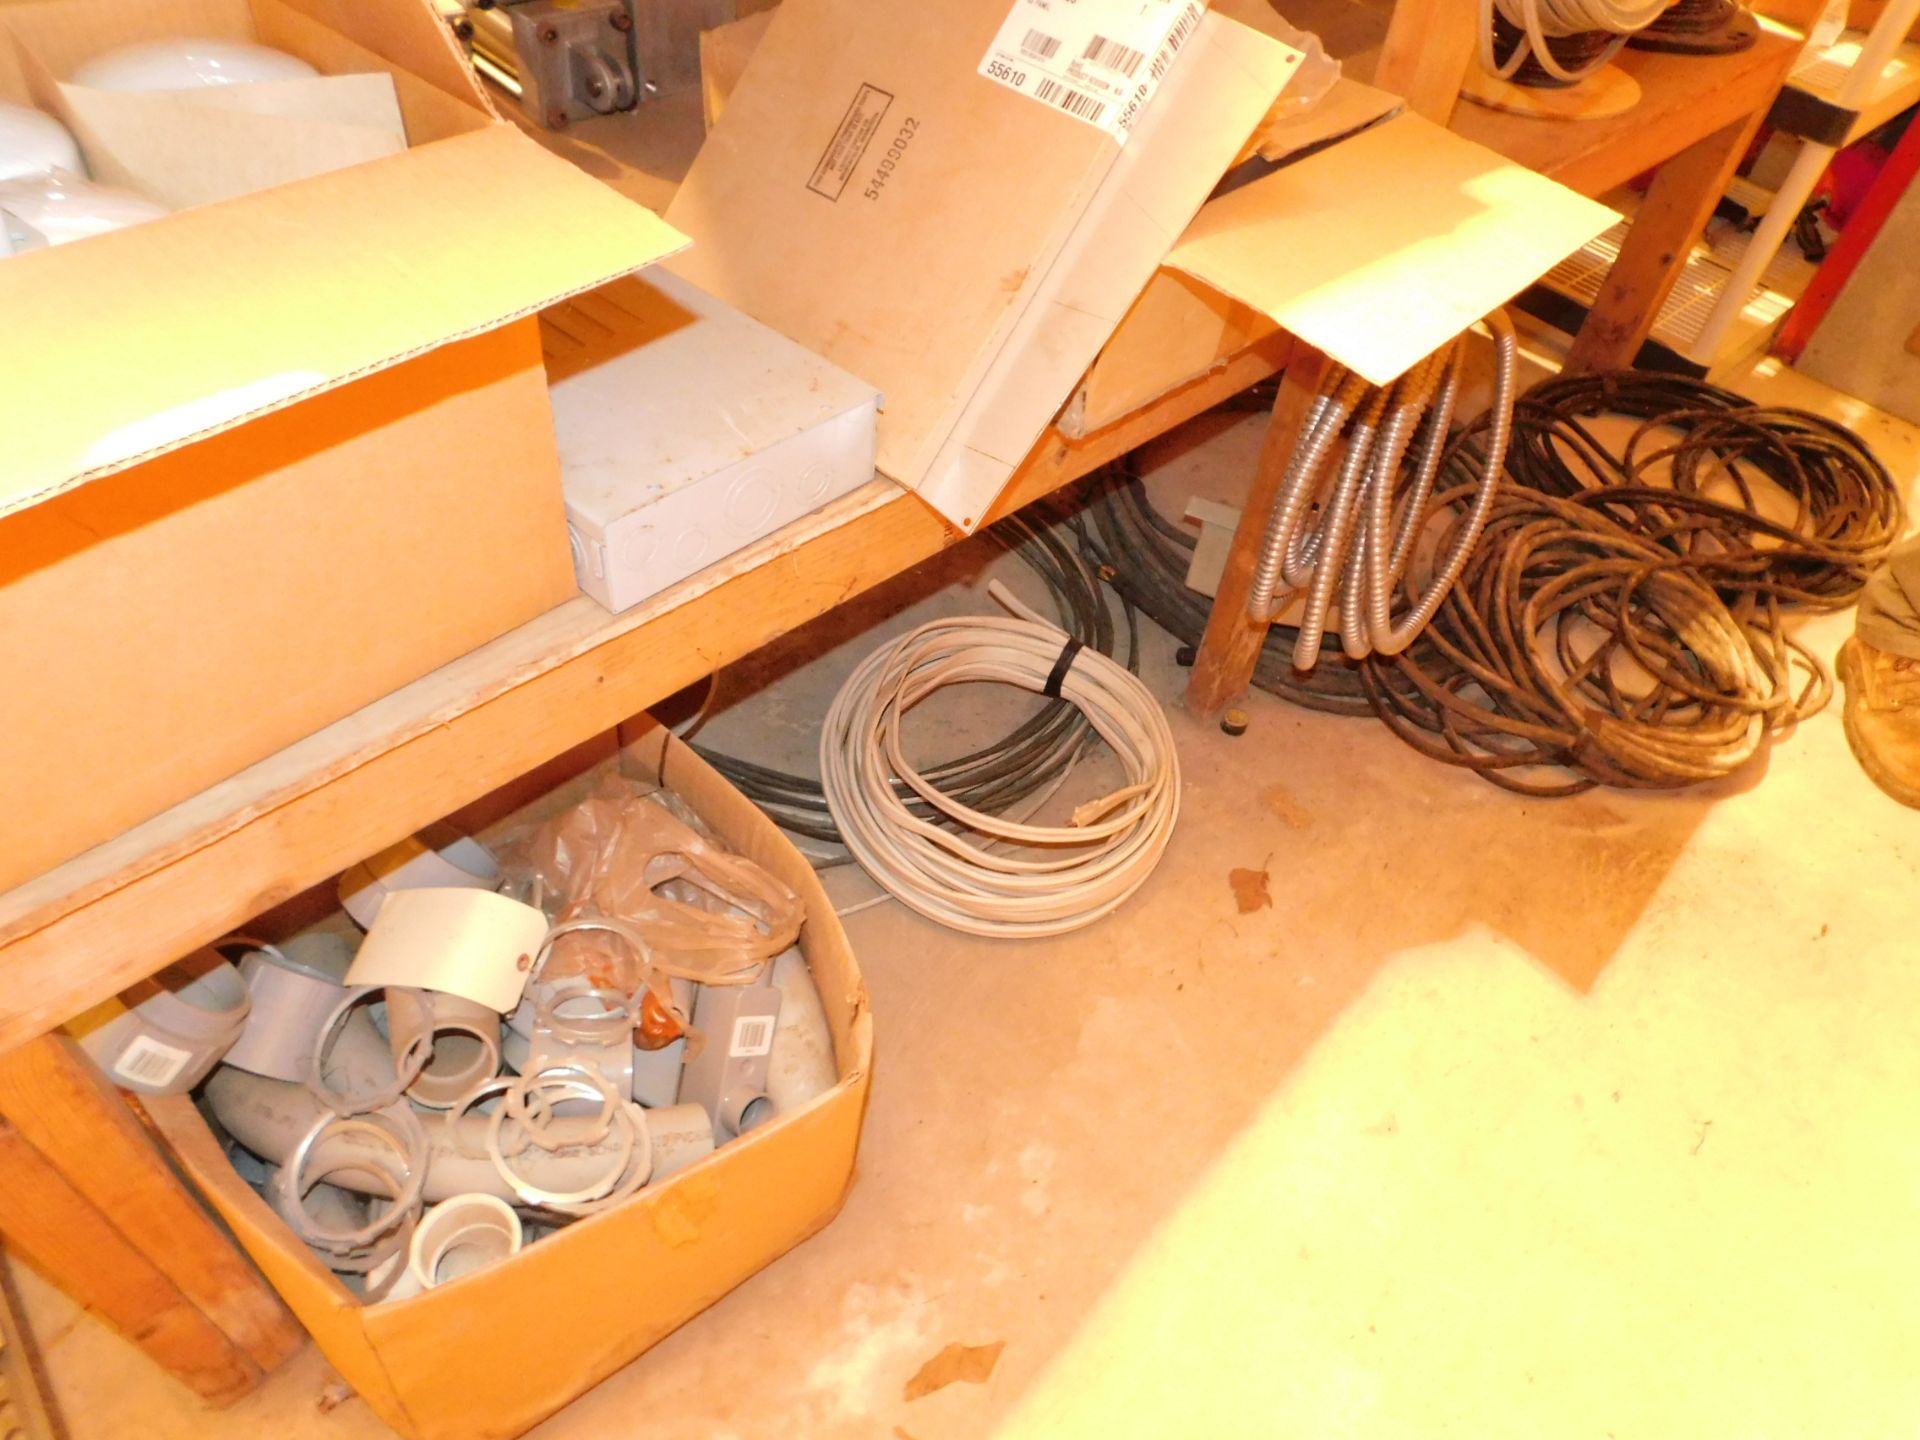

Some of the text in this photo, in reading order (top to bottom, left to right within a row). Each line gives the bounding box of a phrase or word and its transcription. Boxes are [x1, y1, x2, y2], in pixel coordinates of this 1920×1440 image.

[987, 60, 1026, 87] 55610
[1118, 84, 1148, 129] 55610
[864, 117, 920, 200] 54499032
